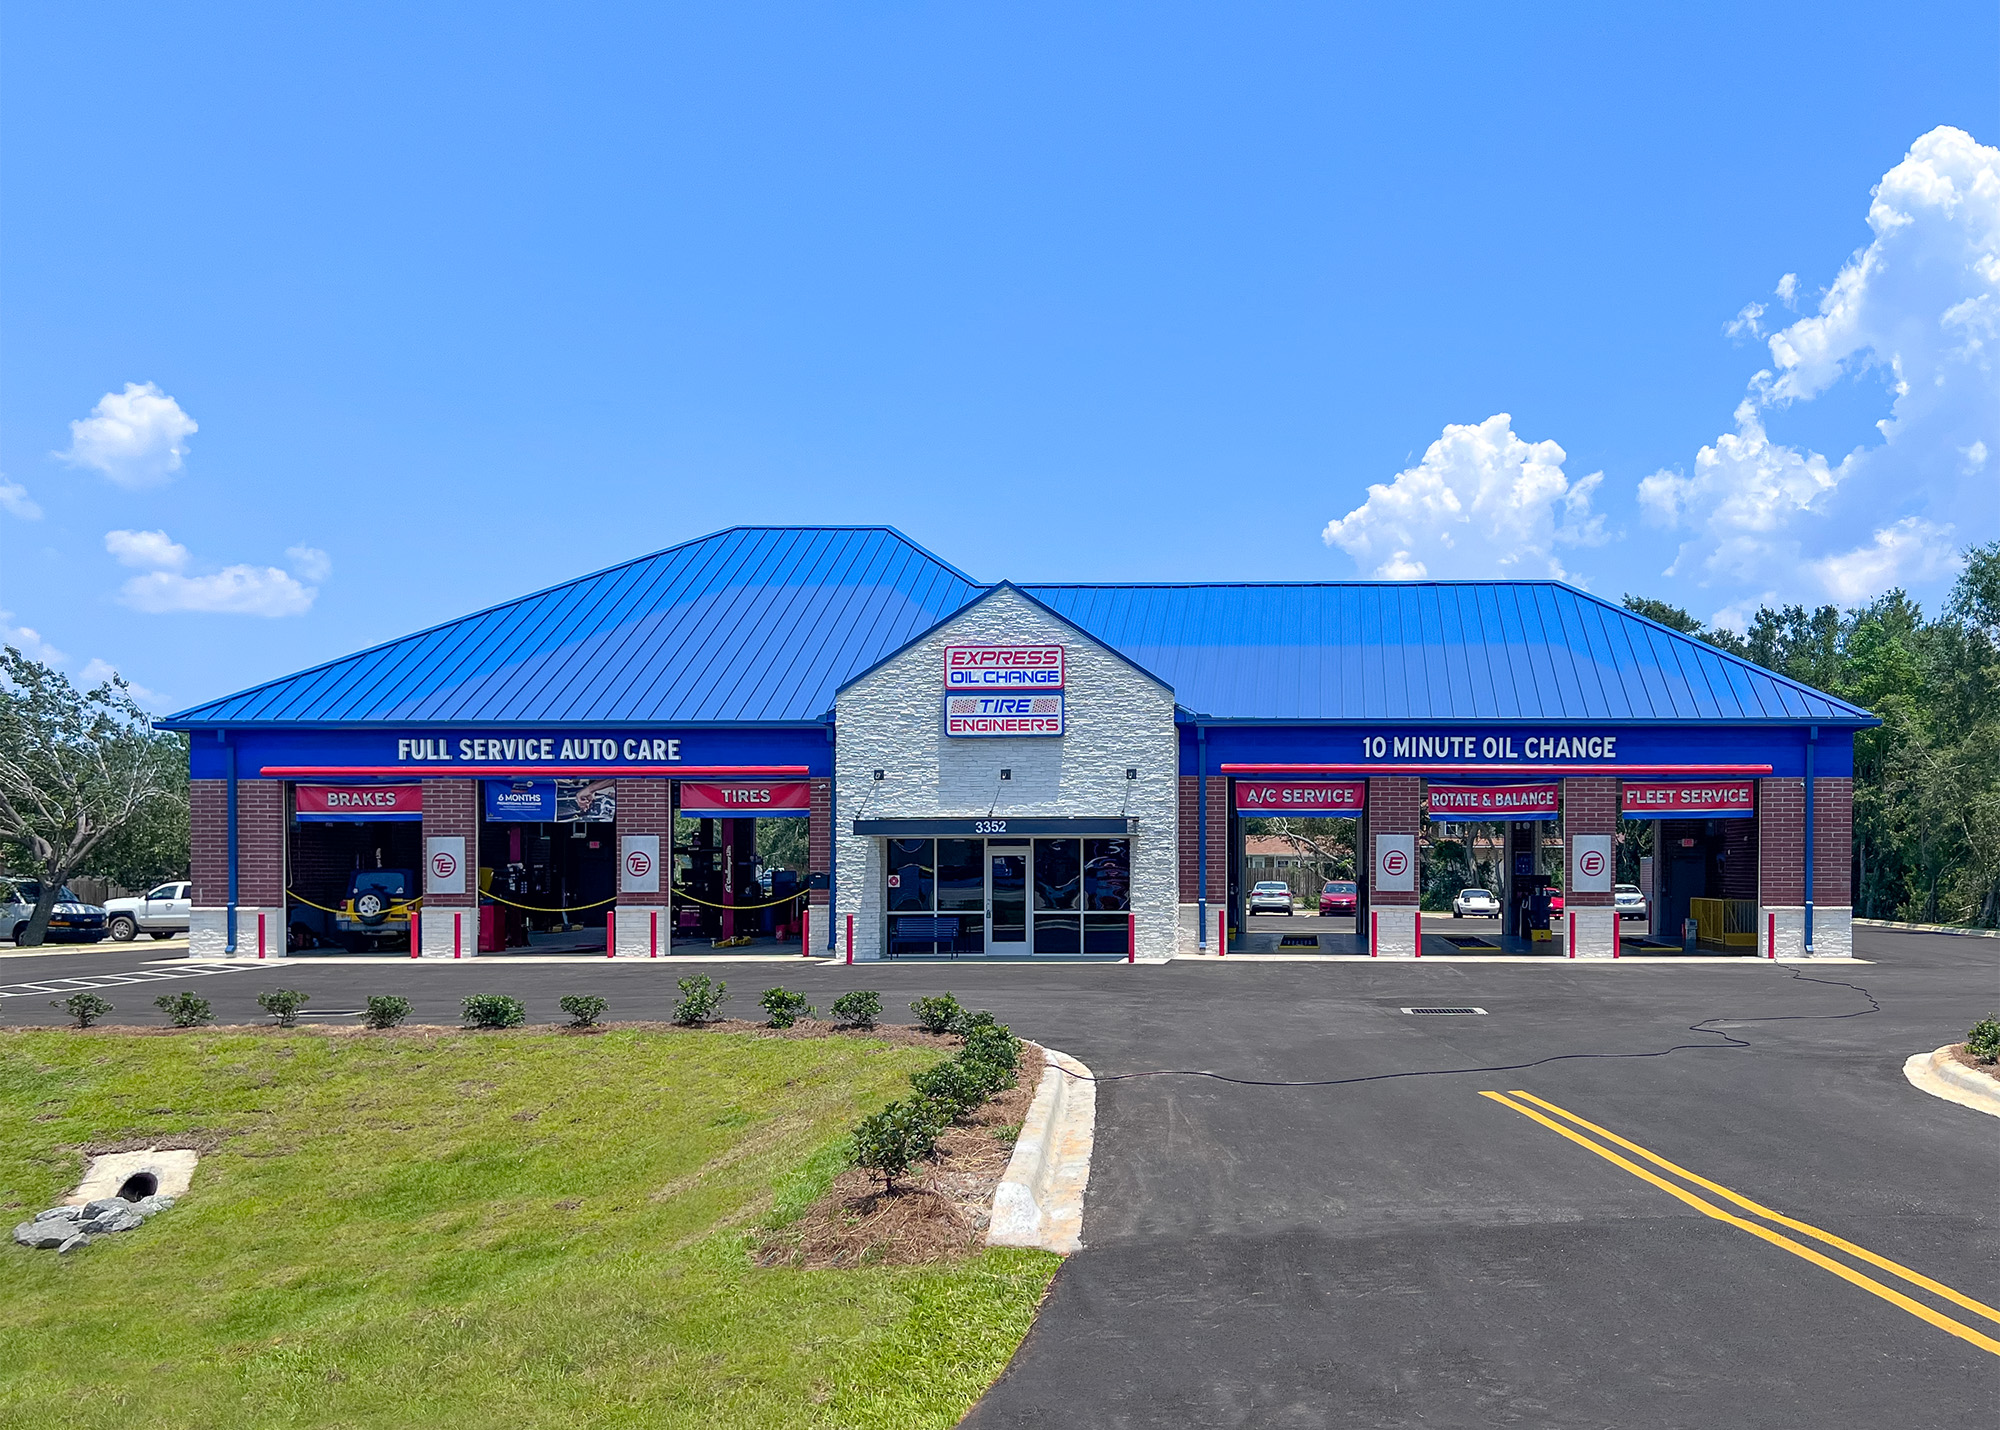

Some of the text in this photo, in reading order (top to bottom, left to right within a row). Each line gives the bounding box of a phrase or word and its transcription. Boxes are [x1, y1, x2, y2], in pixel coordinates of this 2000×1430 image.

[950, 650, 1059, 665] EXPRESS
[950, 670, 1060, 684] OIL CHANGE
[979, 698, 1033, 714] TIRE
[950, 718, 1059, 732] ENGINEERS
[398, 738, 681, 761] FULL SERVICE AUTO CARE
[1363, 736, 1616, 759] 10 MINUTE OIL CHANGE
[327, 792, 396, 807] BRAKES
[498, 793, 541, 802] 6 MONTHS
[721, 789, 771, 803] TIRES
[1246, 788, 1354, 804] A/C SERVICE
[1430, 791, 1554, 807] ROTATE & BALANCE
[1626, 788, 1749, 804] FLEET SERVICE
[975, 820, 1007, 834] 3352
[434, 858, 453, 873] TE
[629, 857, 648, 872] TE
[1387, 856, 1403, 870] E
[1584, 856, 1601, 870] E
